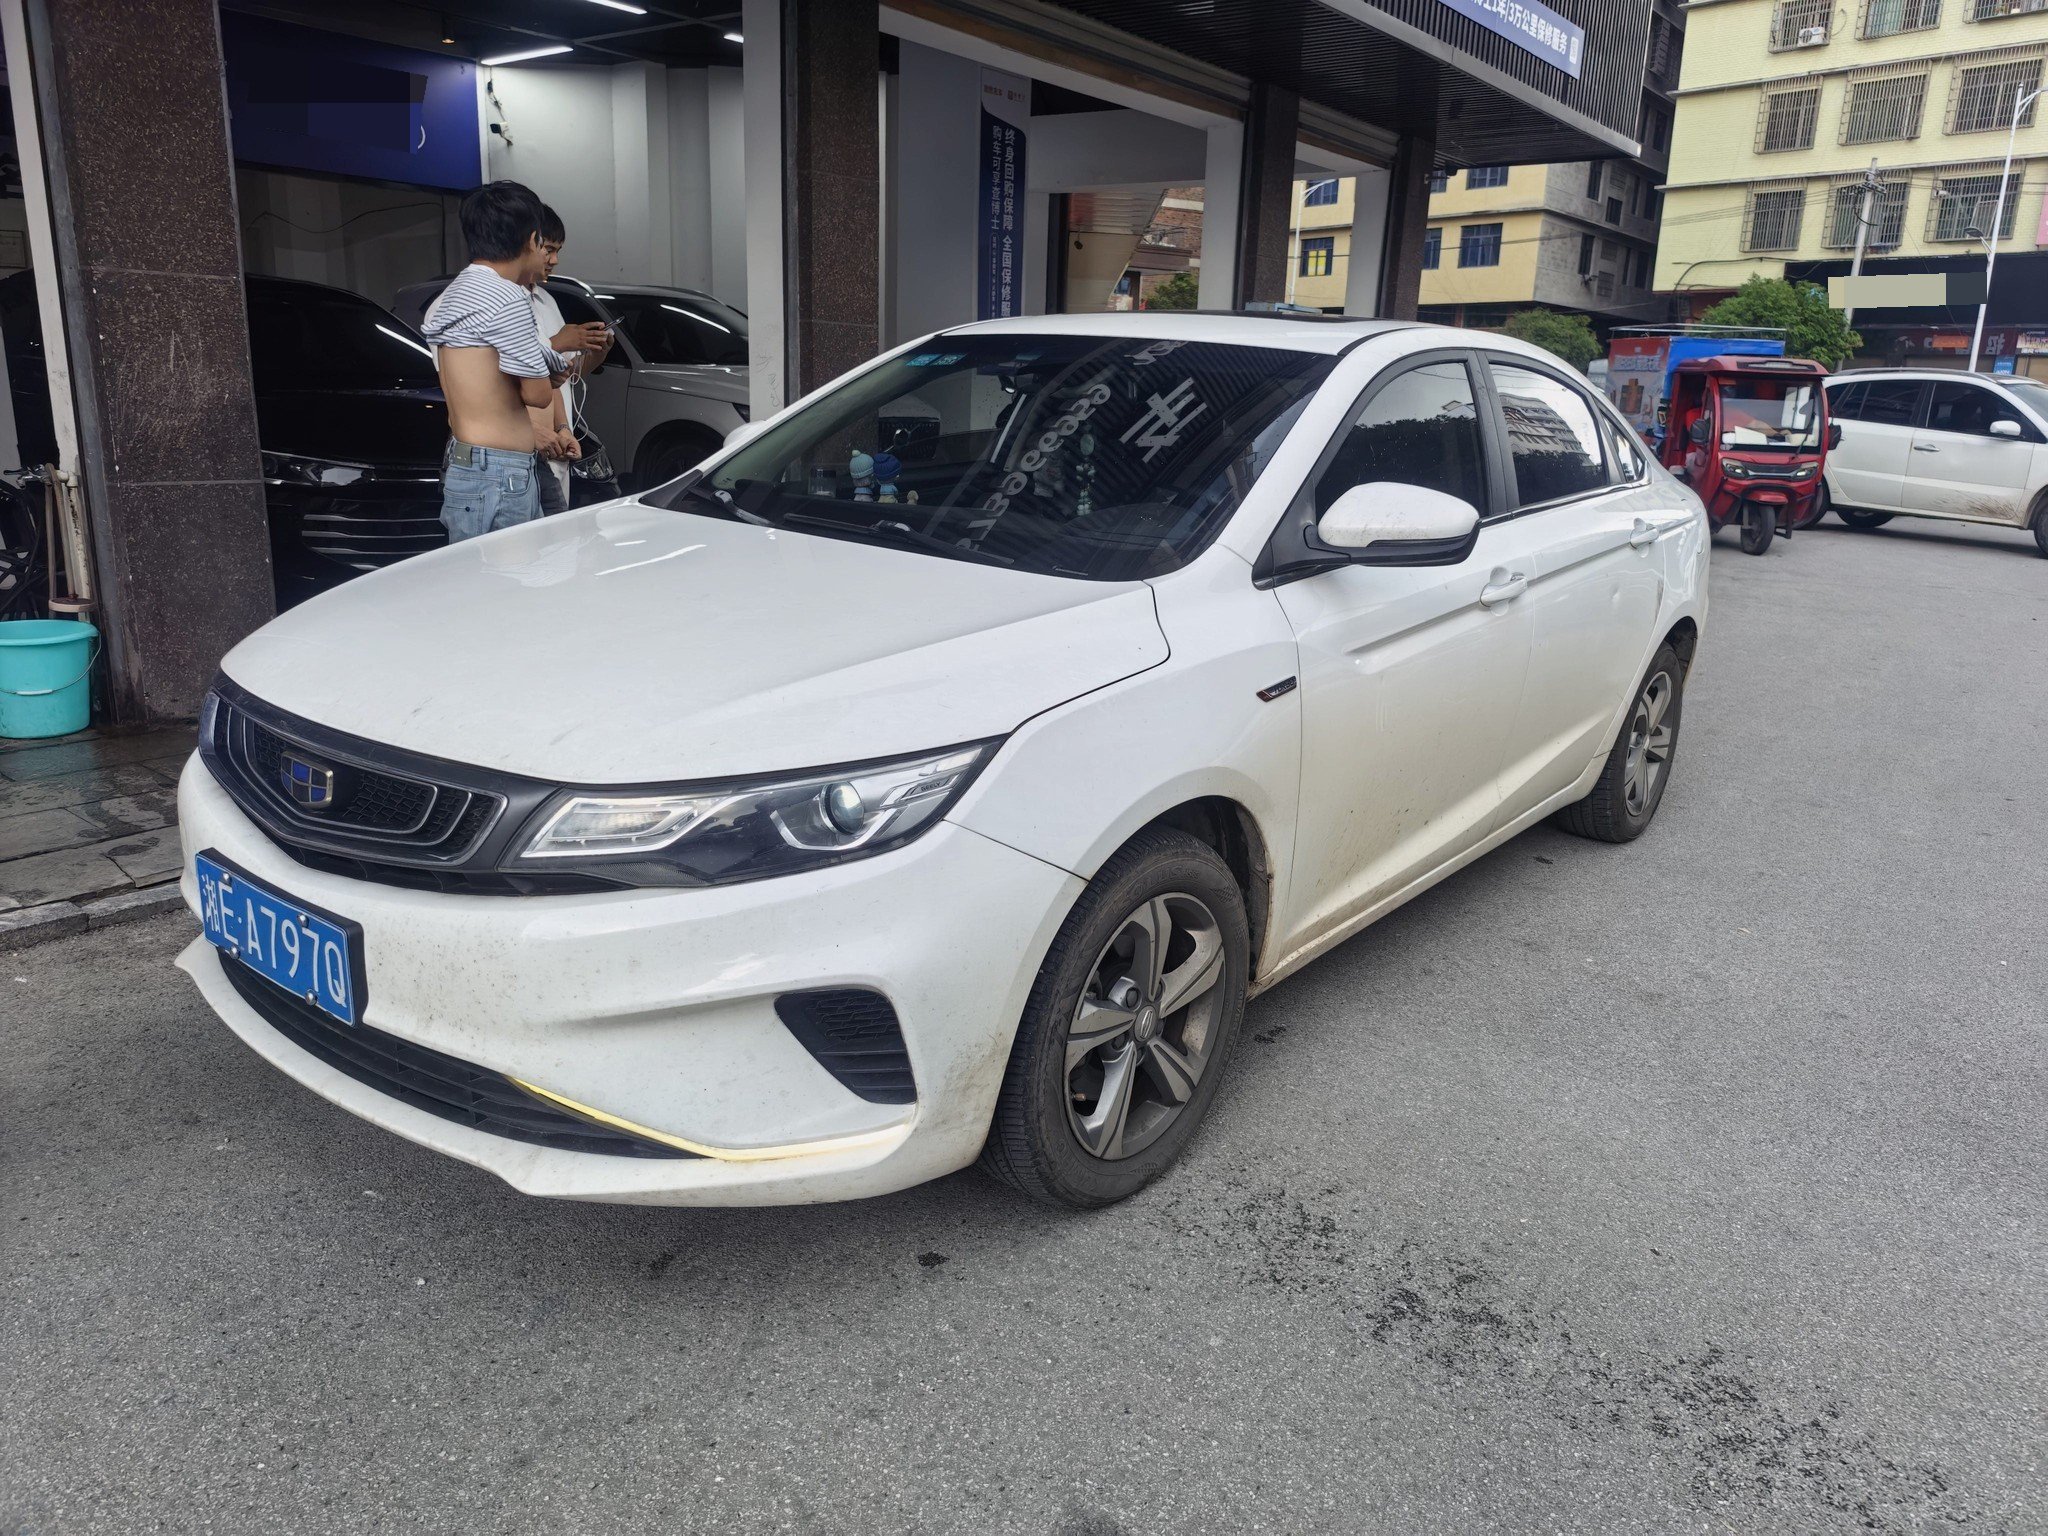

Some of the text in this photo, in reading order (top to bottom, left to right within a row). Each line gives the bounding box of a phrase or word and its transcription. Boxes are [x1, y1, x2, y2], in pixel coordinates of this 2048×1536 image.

[1474, 0, 1568, 55] 1年/3万公里保修服务
[991, 125, 1002, 230] 购车可享查博士
[1002, 128, 1016, 232] 终身回购保障
